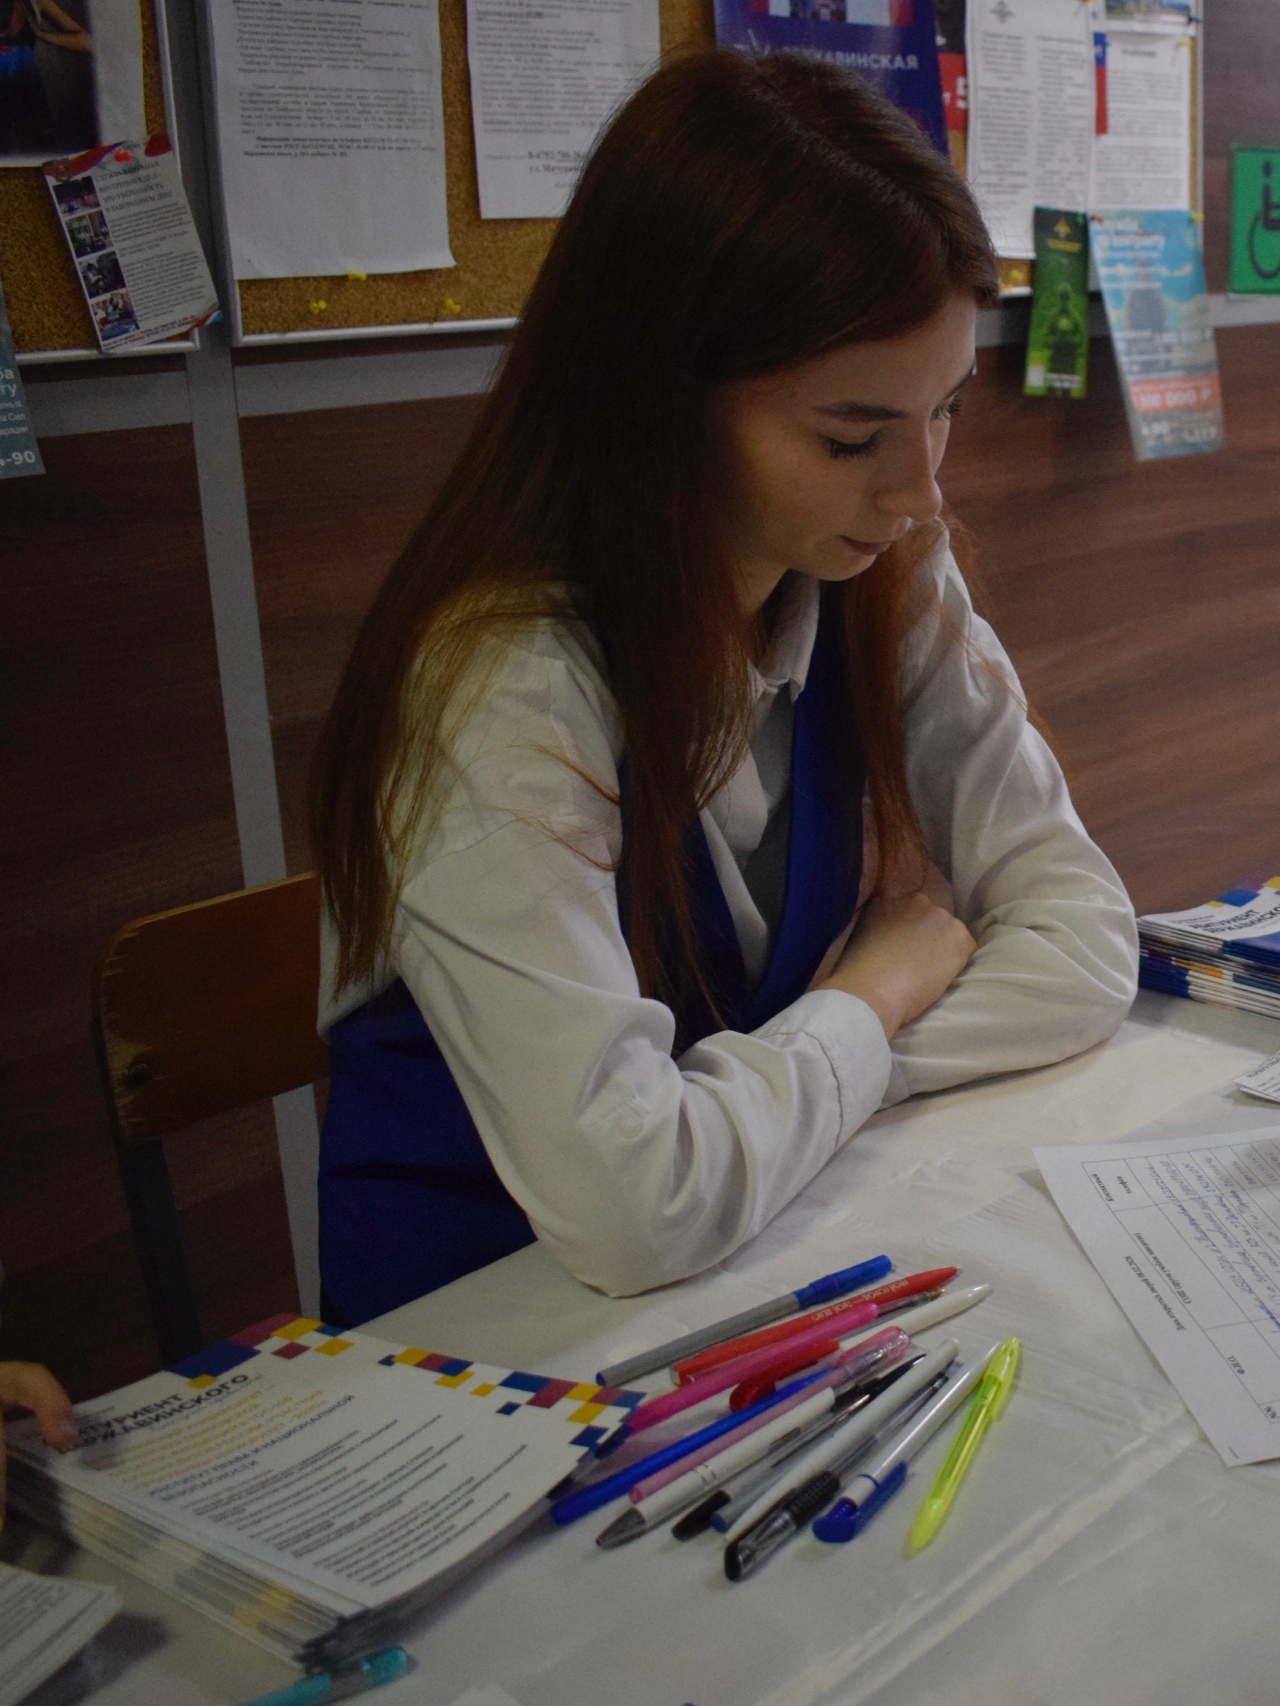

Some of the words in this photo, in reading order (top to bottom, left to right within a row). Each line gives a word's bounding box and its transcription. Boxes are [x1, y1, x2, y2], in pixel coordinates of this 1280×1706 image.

[1091, 1173, 1115, 1202] Контактный
[1116, 1175, 1133, 1194] телефон
[1176, 1289, 1192, 1305] СОШ
[1224, 1354, 1248, 1375] Ф.И.О.
